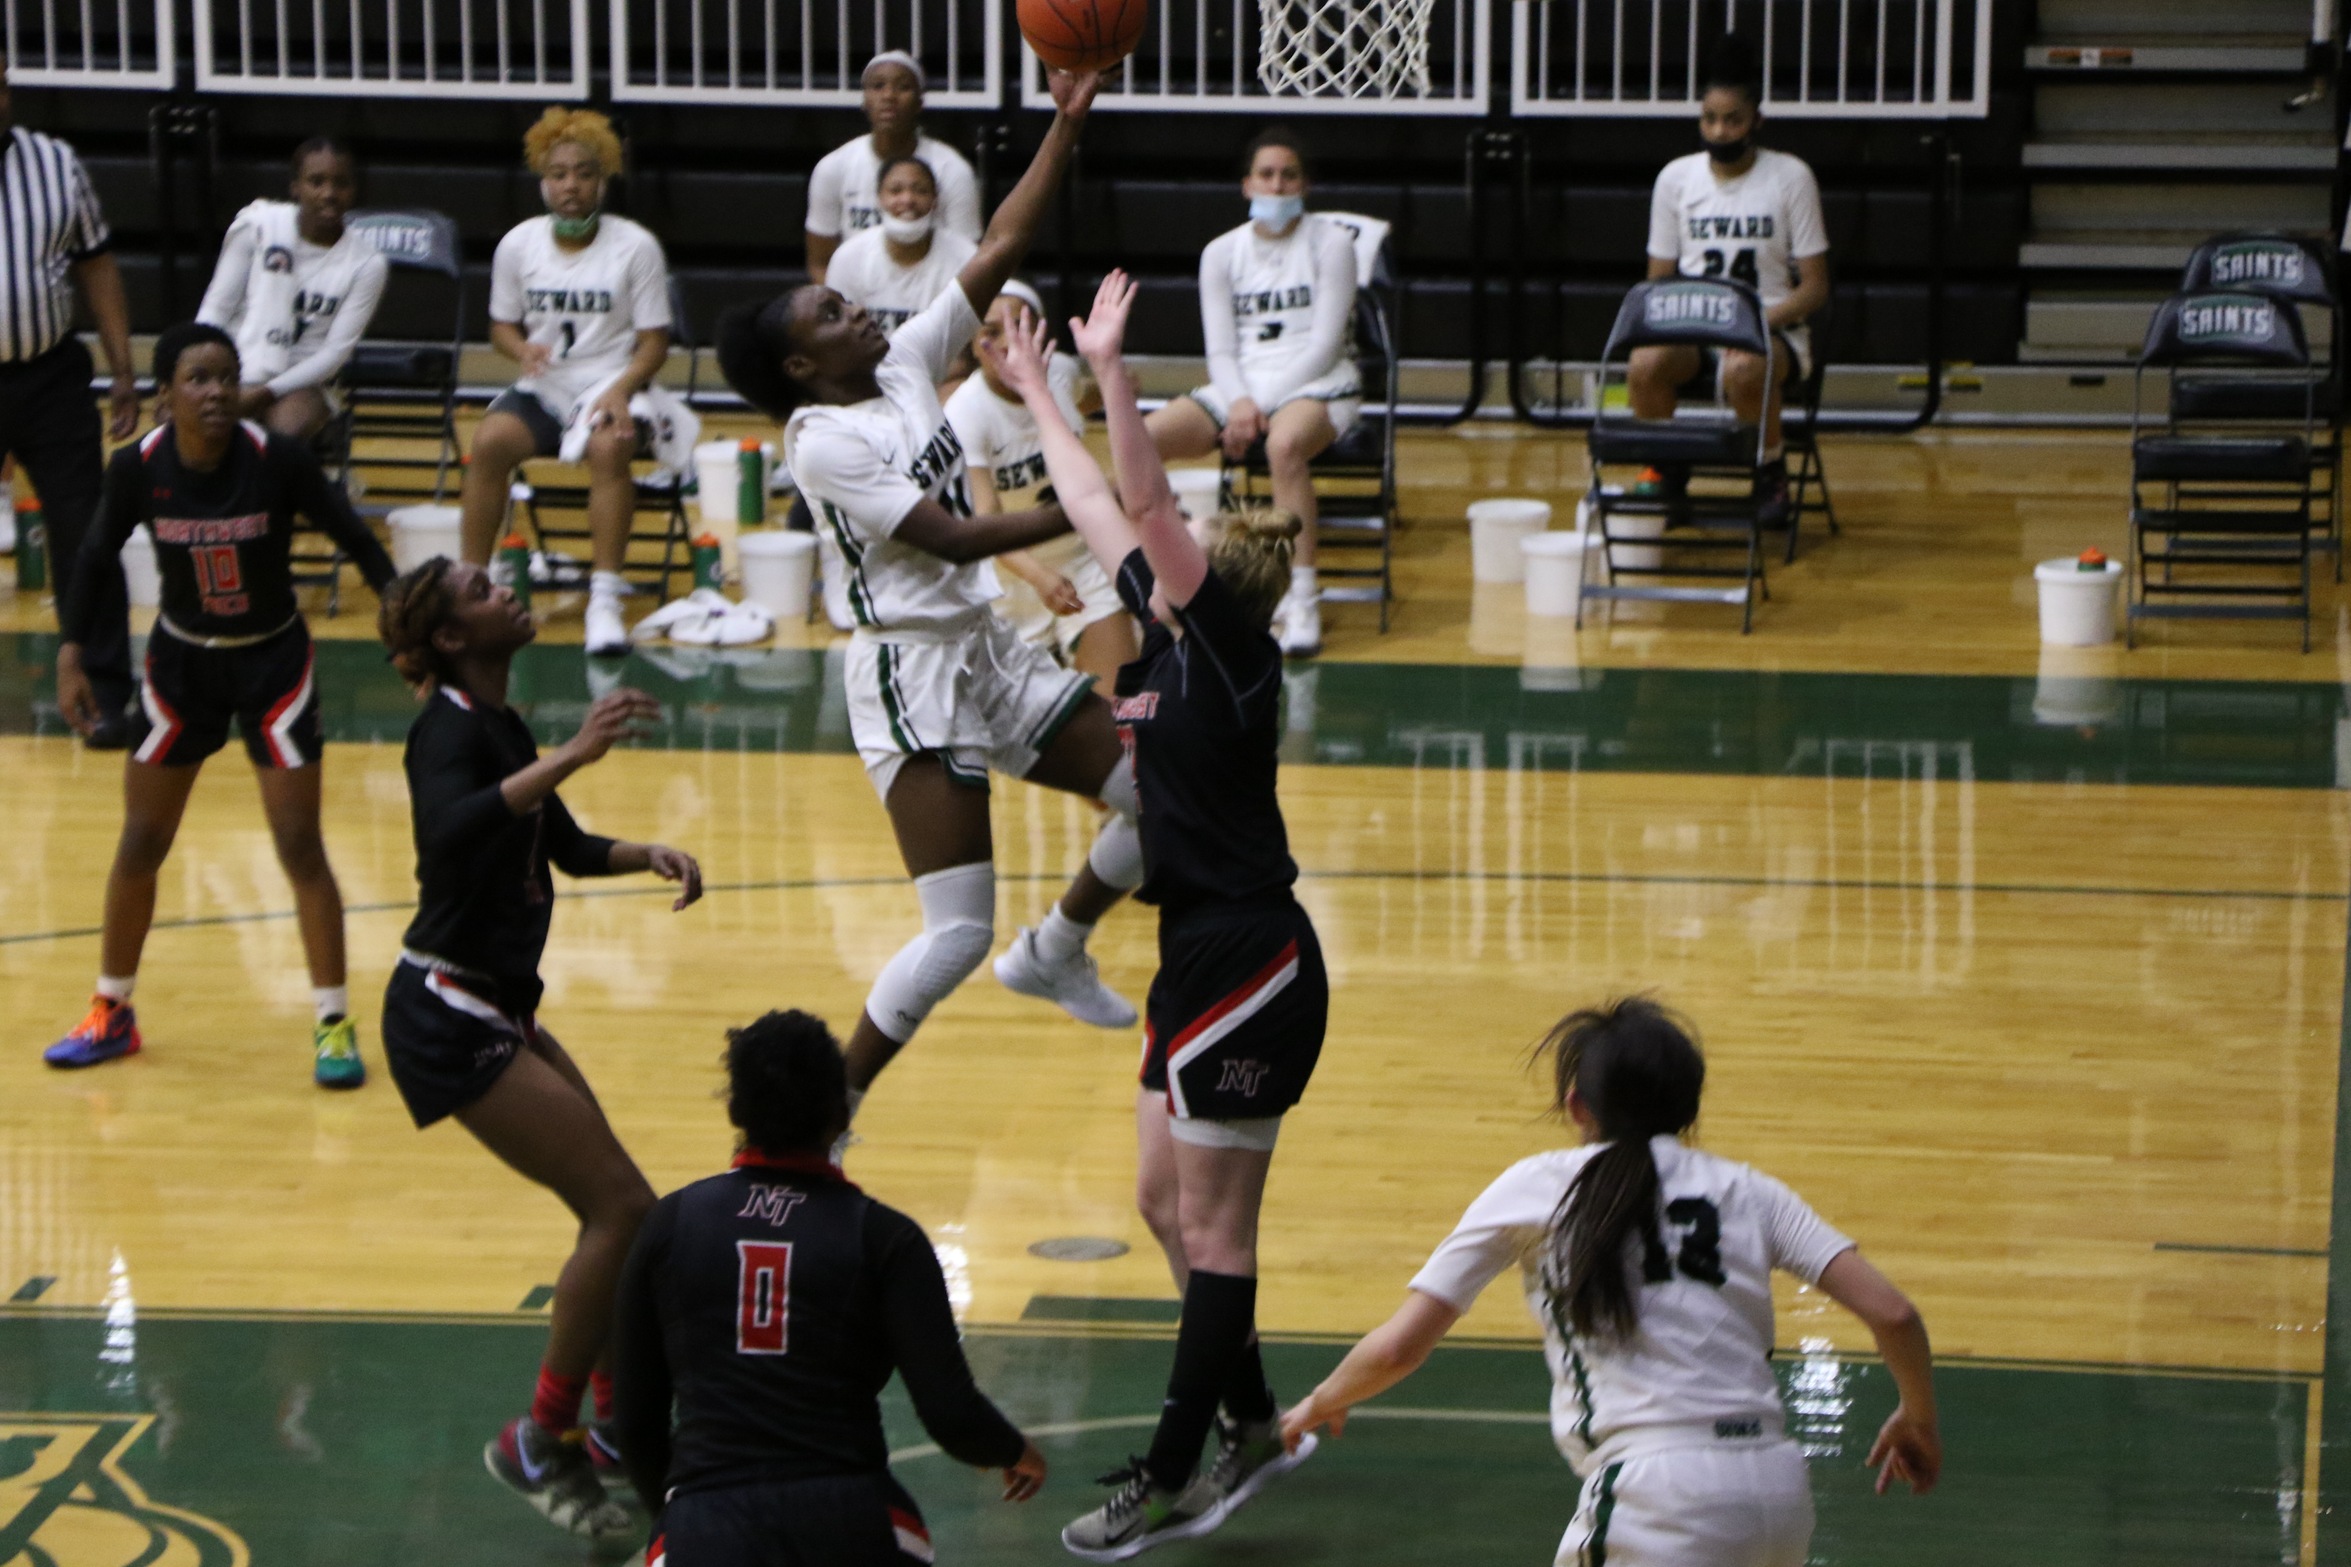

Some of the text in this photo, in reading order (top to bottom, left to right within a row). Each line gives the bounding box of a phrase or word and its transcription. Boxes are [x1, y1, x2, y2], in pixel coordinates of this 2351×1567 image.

[1688, 216, 1774, 240] SEWARD
[1702, 248, 1759, 289] 24
[2214, 252, 2299, 282] SAINTS
[528, 289, 612, 313] SEWARD
[1232, 286, 1311, 316] SEWARD
[1648, 293, 1733, 322] SAINTS
[2183, 303, 2271, 336] SAINTS
[190, 544, 243, 596] 10
[1215, 1059, 1270, 1098] NT
[737, 1183, 808, 1227] NT
[736, 1240, 794, 1355] 0
